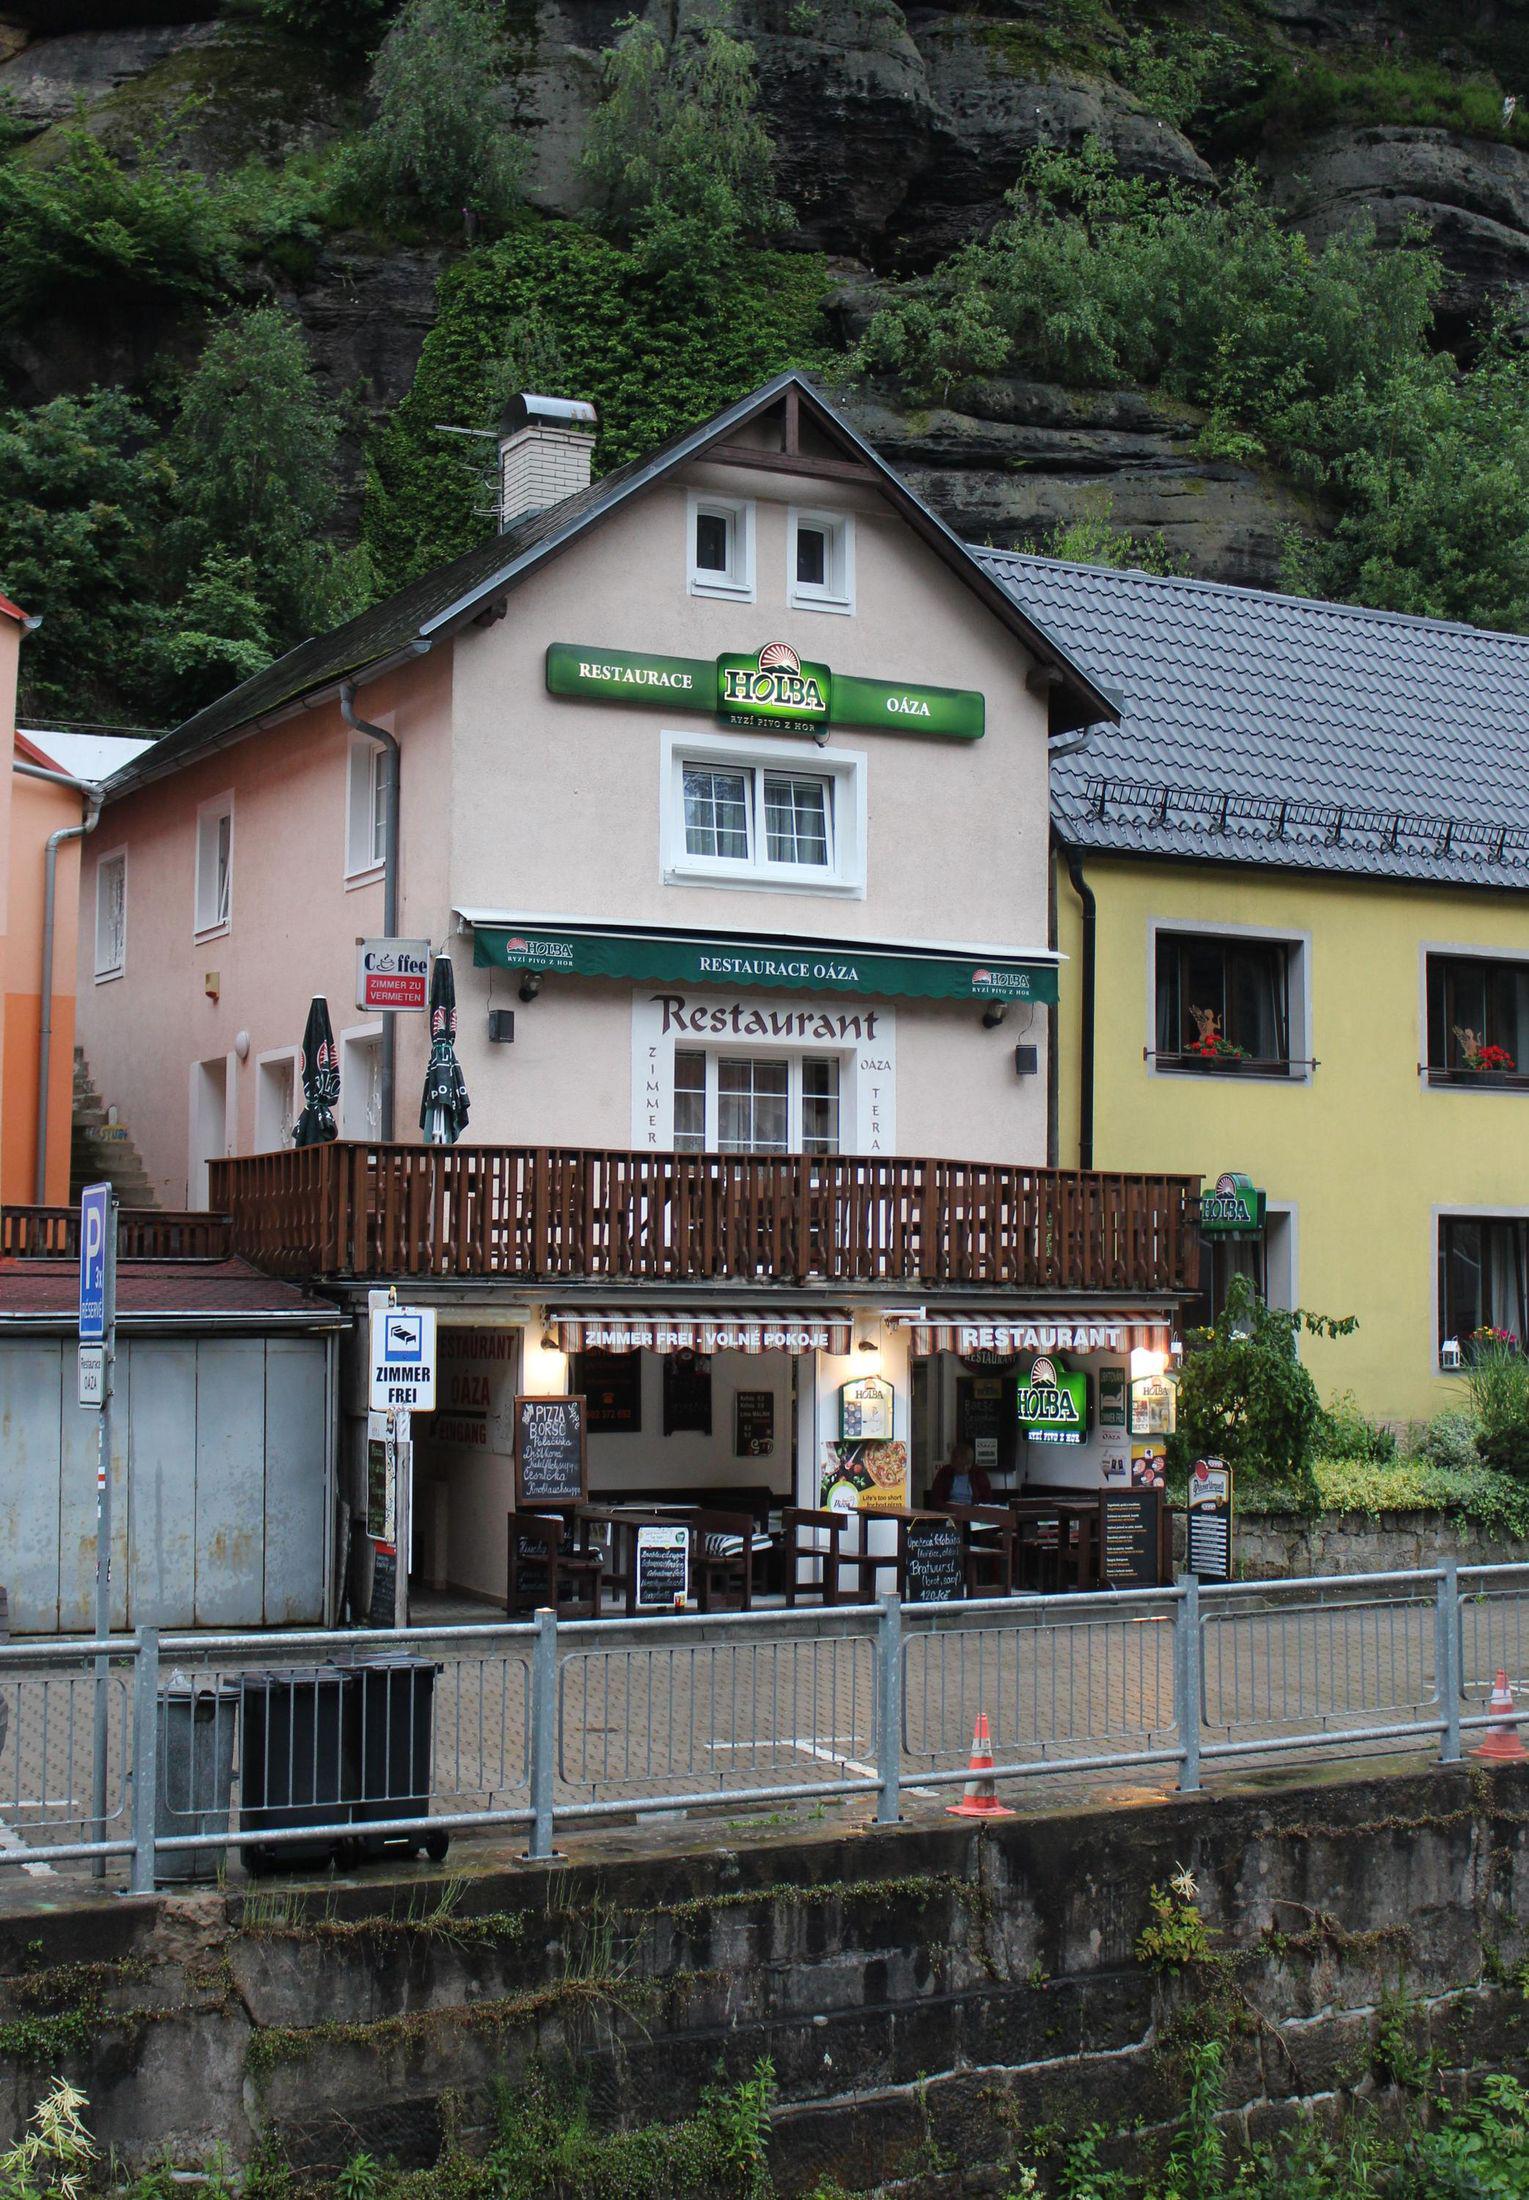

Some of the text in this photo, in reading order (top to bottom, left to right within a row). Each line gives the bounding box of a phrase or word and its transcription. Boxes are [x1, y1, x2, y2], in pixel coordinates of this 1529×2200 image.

[579, 662, 693, 689] RESTAURACE
[725, 669, 826, 711] HOLBA
[886, 696, 931, 717] OÁZA
[731, 715, 816, 732] RYZÍ PIVO Z HOR
[526, 940, 573, 958] HOLBA
[700, 957, 860, 981] RESTAURACE OÁZA
[370, 980, 421, 990] ZIMMER ZU
[987, 972, 1030, 988] HOLBA
[370, 992, 421, 1002] VERMIETEN
[650, 994, 880, 1042] Restaurant
[646, 1046, 660, 1144] ZIMMER
[1202, 1199, 1251, 1222] HOLBA
[85, 1207, 100, 1290] P
[586, 1331, 652, 1346] ZIMMER
[656, 1332, 693, 1346] FREI
[706, 1330, 760, 1346] VOLNÉ
[764, 1333, 829, 1346] POKOJE
[962, 1327, 1121, 1348] RESTAURANT
[440, 1335, 515, 1360] ESTAURANT
[376, 1366, 431, 1383] ZIMMER
[388, 1387, 417, 1404] FREI
[855, 1390, 885, 1400] HOLBA
[1143, 1387, 1169, 1396] HOLBA
[535, 1405, 566, 1422] PIZZA
[1017, 1388, 1080, 1421] HOLBA
[887, 1494, 902, 1503] short
